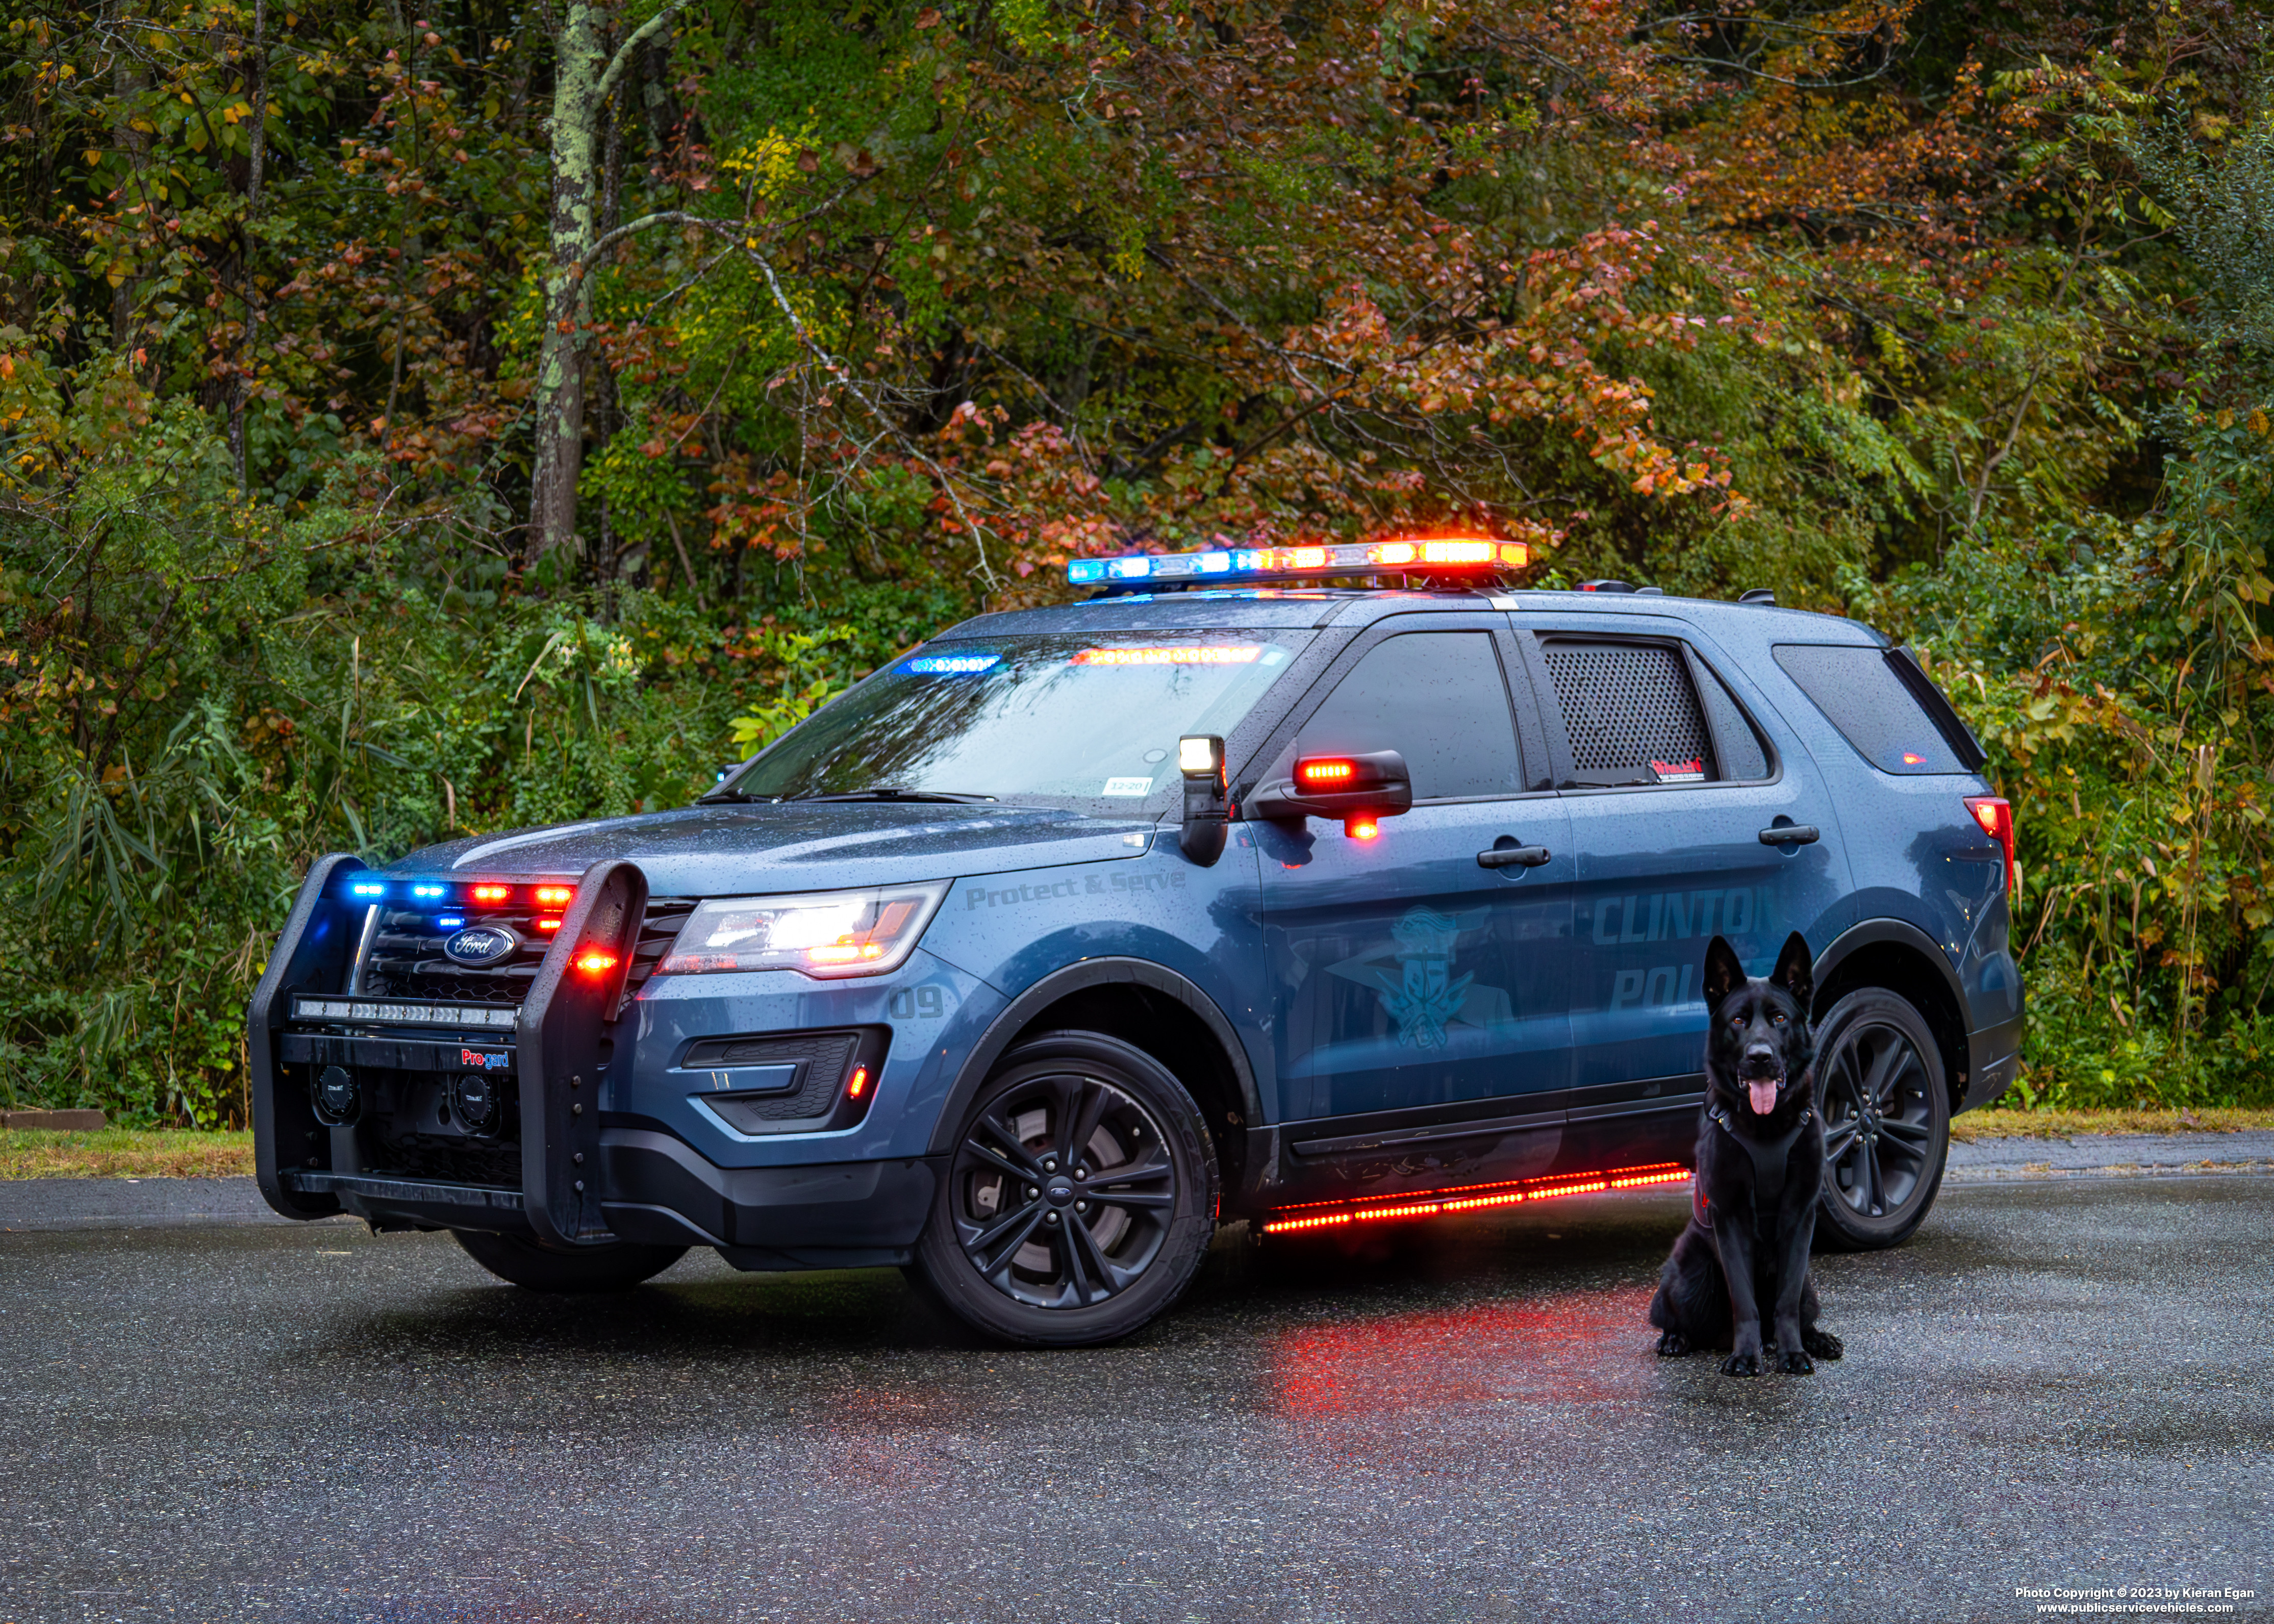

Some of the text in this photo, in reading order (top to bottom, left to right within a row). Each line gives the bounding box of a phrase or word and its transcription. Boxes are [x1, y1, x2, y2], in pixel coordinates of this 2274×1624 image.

[966, 871, 1186, 911] Protect & Serve
[454, 932, 494, 954] Ford
[889, 986, 944, 1019] 09
[461, 1049, 509, 1070] Pro-gard
